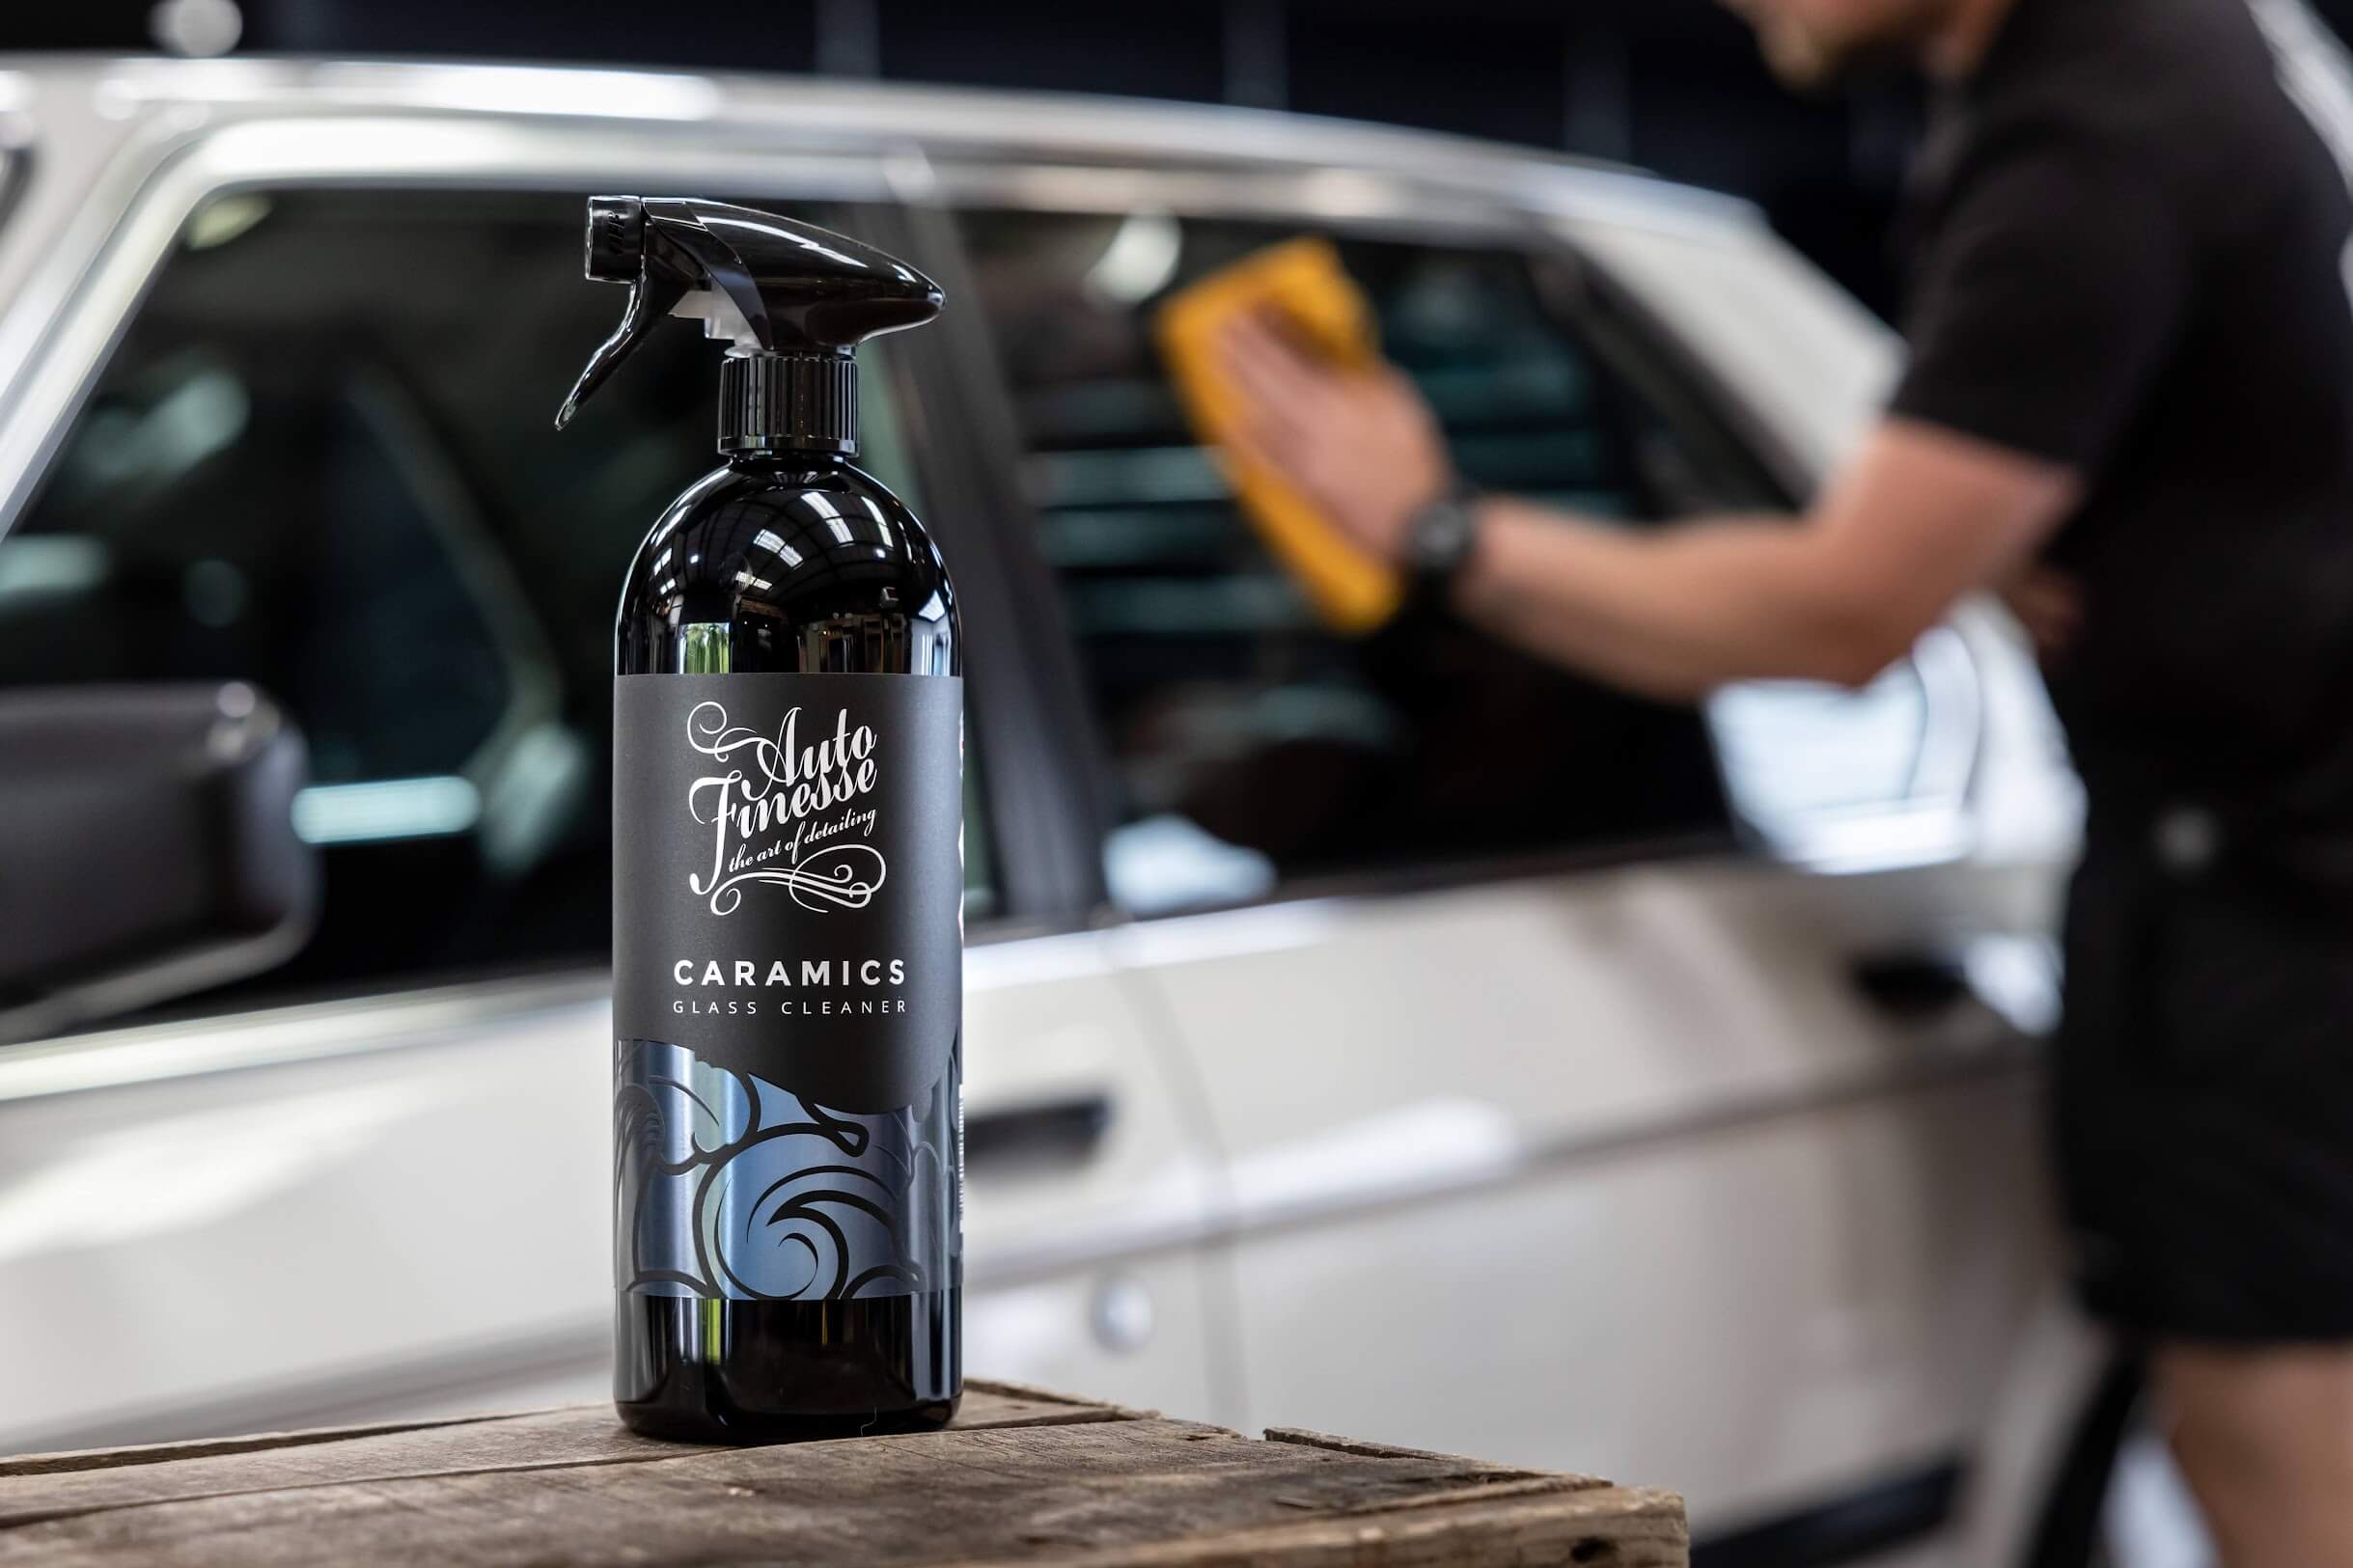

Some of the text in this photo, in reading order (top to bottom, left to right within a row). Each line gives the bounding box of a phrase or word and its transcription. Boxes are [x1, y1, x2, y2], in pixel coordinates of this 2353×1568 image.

[687, 701, 877, 801] Auto
[688, 757, 877, 895] Finesse
[729, 808, 876, 872] the art of detailing
[674, 959, 905, 986] CARAMICS
[673, 1000, 905, 1015] GLASS CLEANER
